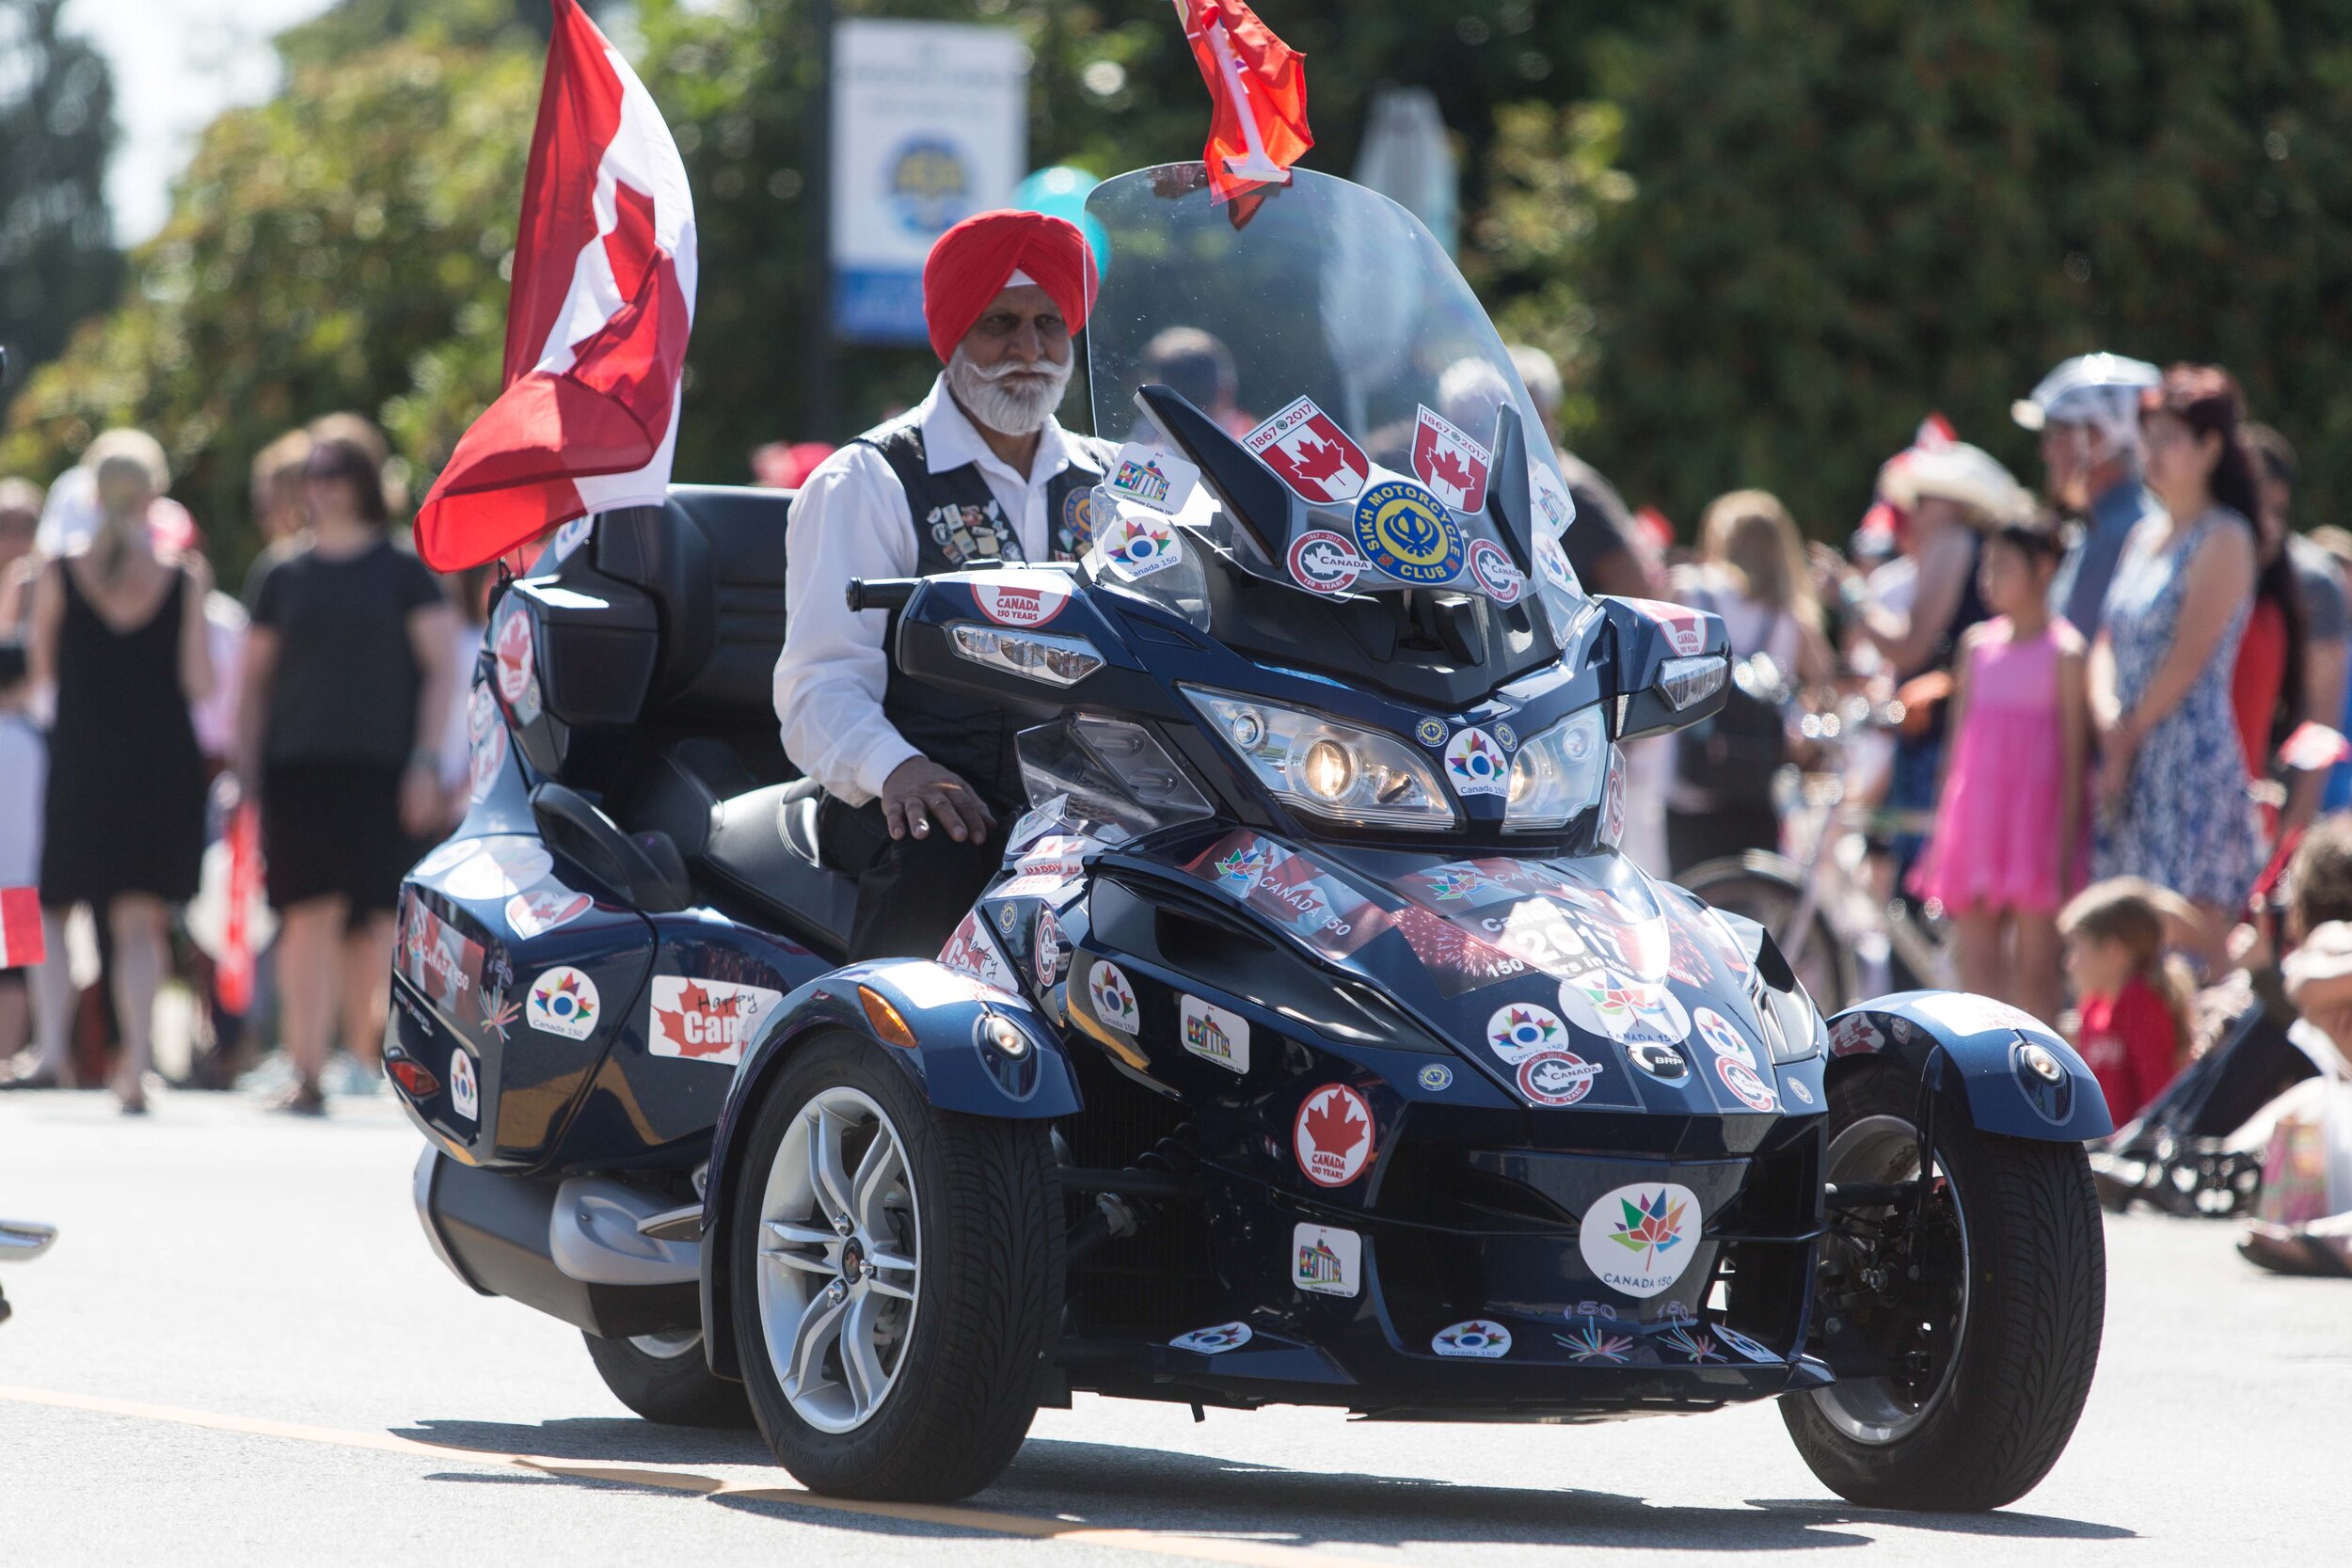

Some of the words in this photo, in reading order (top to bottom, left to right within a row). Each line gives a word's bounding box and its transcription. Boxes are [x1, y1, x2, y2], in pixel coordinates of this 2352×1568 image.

[1250, 426, 1277, 448] 1867
[1285, 404, 1312, 424] 2017
[1422, 413, 1450, 434] 1867
[1461, 439, 1486, 461] 2017
[1122, 494, 1146, 507] Celebrate
[1146, 502, 1165, 514] Canada
[1359, 508, 1380, 551] SIKH
[1368, 485, 1460, 558] MOTORCYCLE
[1162, 555, 1178, 566] 150
[1320, 556, 1368, 569] CANADA
[1400, 564, 1447, 579] CLUB
[1491, 564, 1523, 578] CANADA
[1304, 578, 1316, 587] 150
[1321, 578, 1345, 590] YEARS
[996, 597, 1040, 612] CANADA
[997, 610, 1010, 618] 150
[1011, 610, 1038, 621] YEARS
[1677, 633, 1699, 645] CANADA
[1460, 784, 1493, 795] Canada
[1494, 786, 1505, 795] 150
[1259, 876, 1323, 919] CANADA
[1321, 914, 1352, 936] 150
[1482, 907, 1577, 932] Canada
[1515, 922, 1629, 964] 2017
[963, 929, 999, 980] Happy
[1486, 958, 1525, 977] 150
[697, 992, 758, 1015] Happy
[532, 1019, 565, 1034] Canada
[683, 1009, 739, 1045] Can
[1101, 1013, 1123, 1029] Canada
[1124, 1022, 1136, 1033] 150
[1606, 1031, 1654, 1041] CANADA
[1658, 1034, 1678, 1042] 150
[1654, 1055, 1682, 1066] BRP
[1550, 1066, 1599, 1081] CANADA
[1562, 1087, 1584, 1101] YEARS
[1311, 1153, 1345, 1170] CANADA
[1323, 1168, 1343, 1180] YEARS
[1603, 1273, 1655, 1289] CANADA
[1658, 1276, 1672, 1288] 150
[1564, 1301, 1617, 1322] 150
[1658, 1301, 1689, 1320] 150
